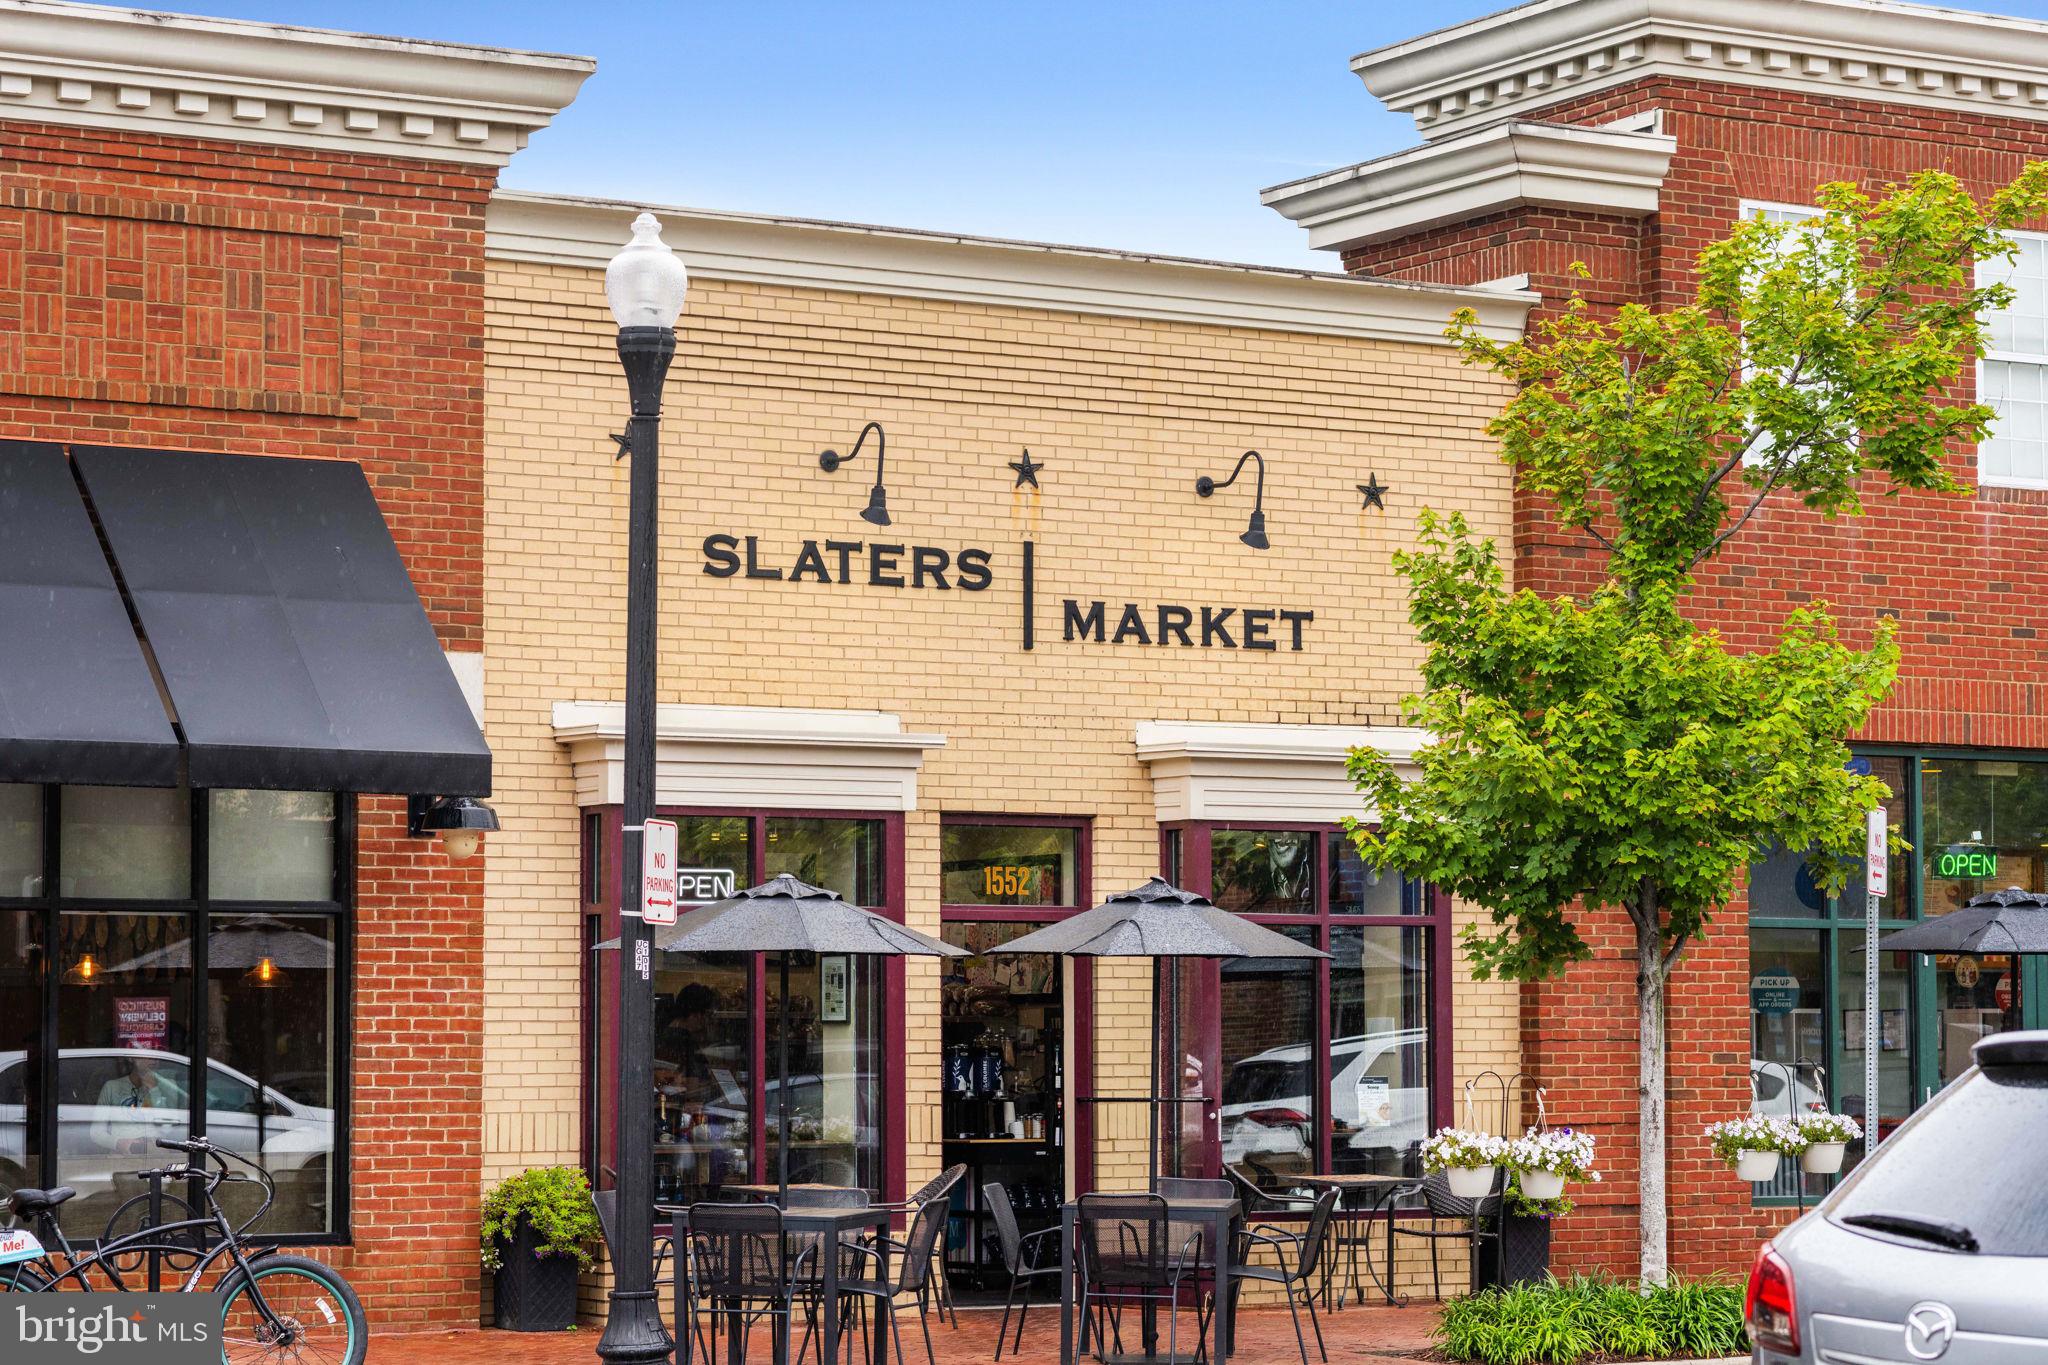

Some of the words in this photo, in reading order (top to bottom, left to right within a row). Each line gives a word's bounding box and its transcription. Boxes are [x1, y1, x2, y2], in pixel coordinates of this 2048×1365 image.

[702, 534, 993, 591] SLATERS
[1063, 600, 1314, 651] MARKET
[654, 852, 666, 869] NO
[1941, 854, 1997, 876] OPEN
[646, 876, 674, 893] PARKING
[678, 875, 731, 898] PEN
[984, 866, 1030, 895] 1552
[3, 1239, 25, 1252] Me!
